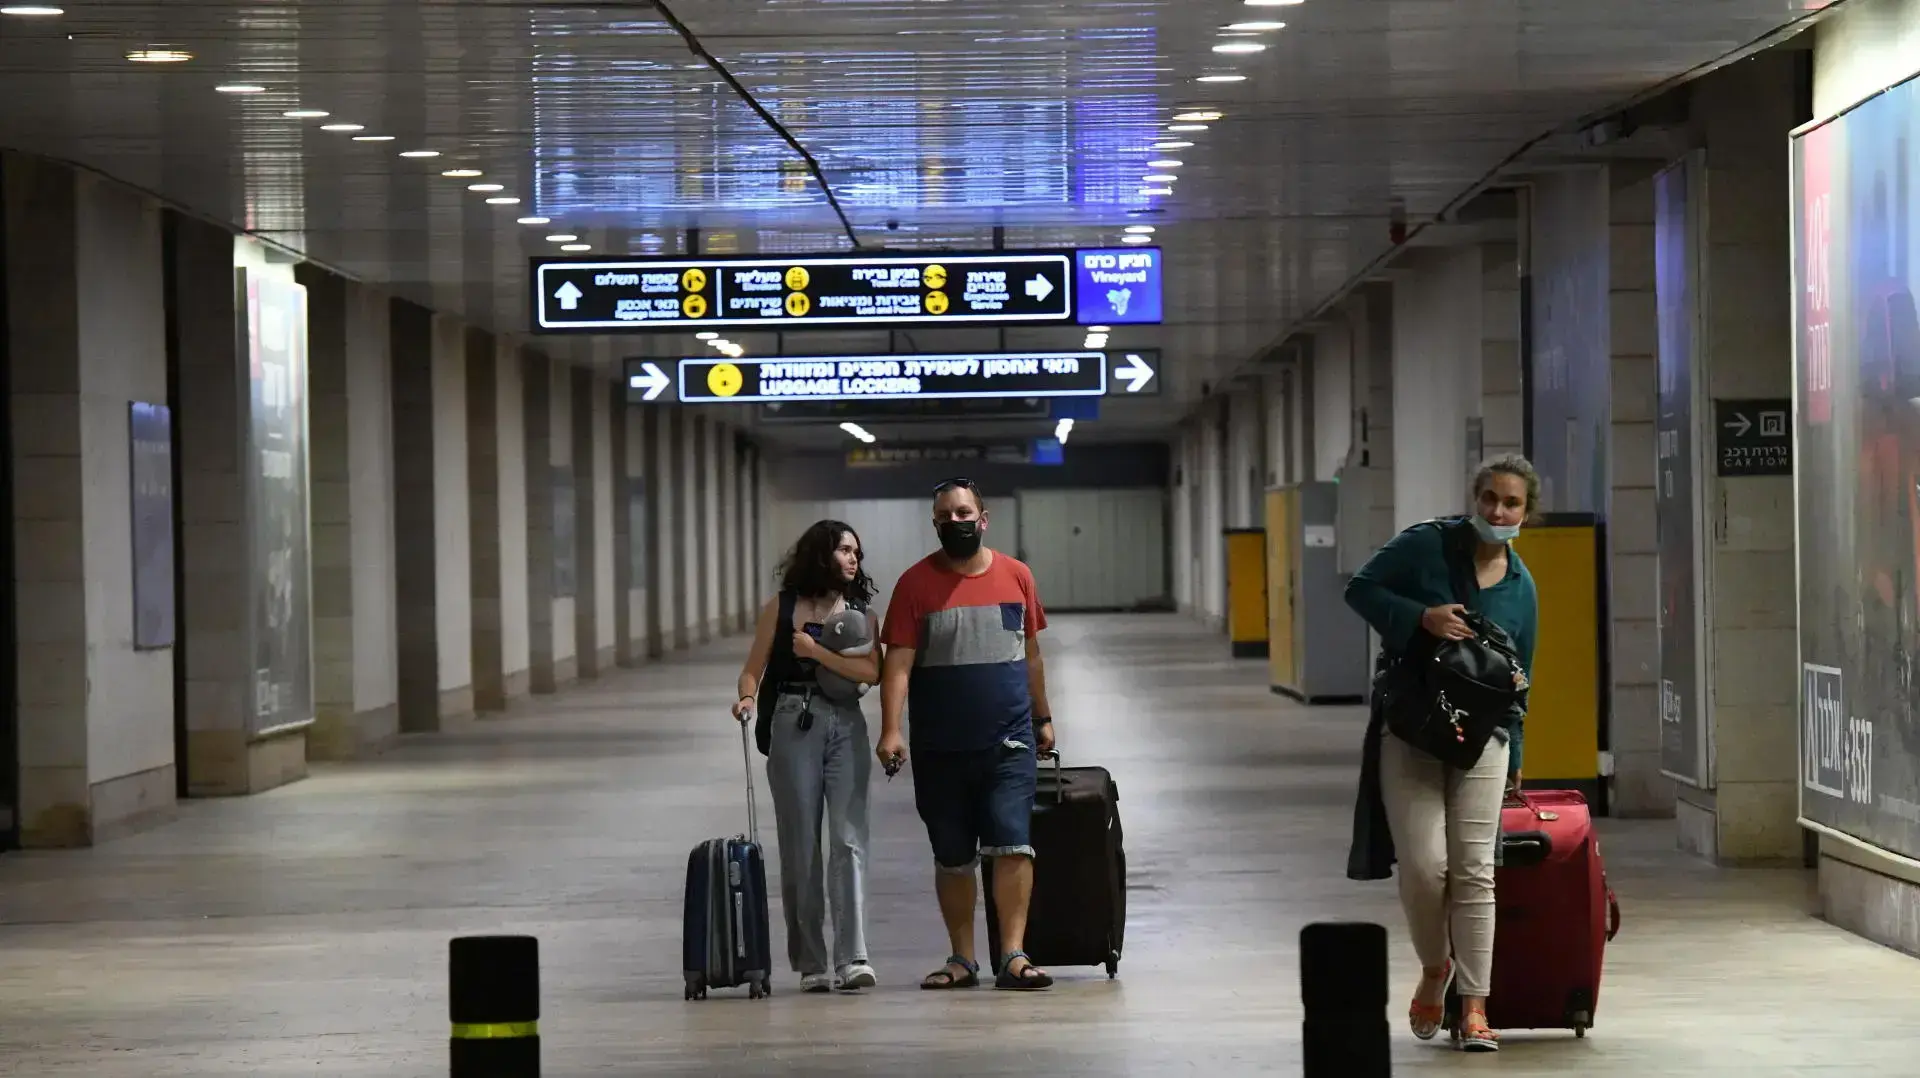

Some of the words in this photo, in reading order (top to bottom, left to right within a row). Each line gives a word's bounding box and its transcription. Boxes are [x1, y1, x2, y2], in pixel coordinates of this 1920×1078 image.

[1091, 270, 1147, 285] Vineyard
[730, 298, 782, 309] שירותים
[759, 362, 835, 378] ומזוודות
[838, 361, 900, 377] חפצים
[904, 358, 981, 376] לשמירת
[983, 358, 1038, 378] אחסון
[1042, 358, 1079, 373] תאי
[760, 379, 840, 396] LUGGAGE
[842, 376, 922, 394] LOCKERS
[1723, 447, 1748, 458] רכב
[1752, 446, 1788, 457] גרירת
[1723, 458, 1751, 468] CAR
[1817, 682, 1841, 771] אלבר
